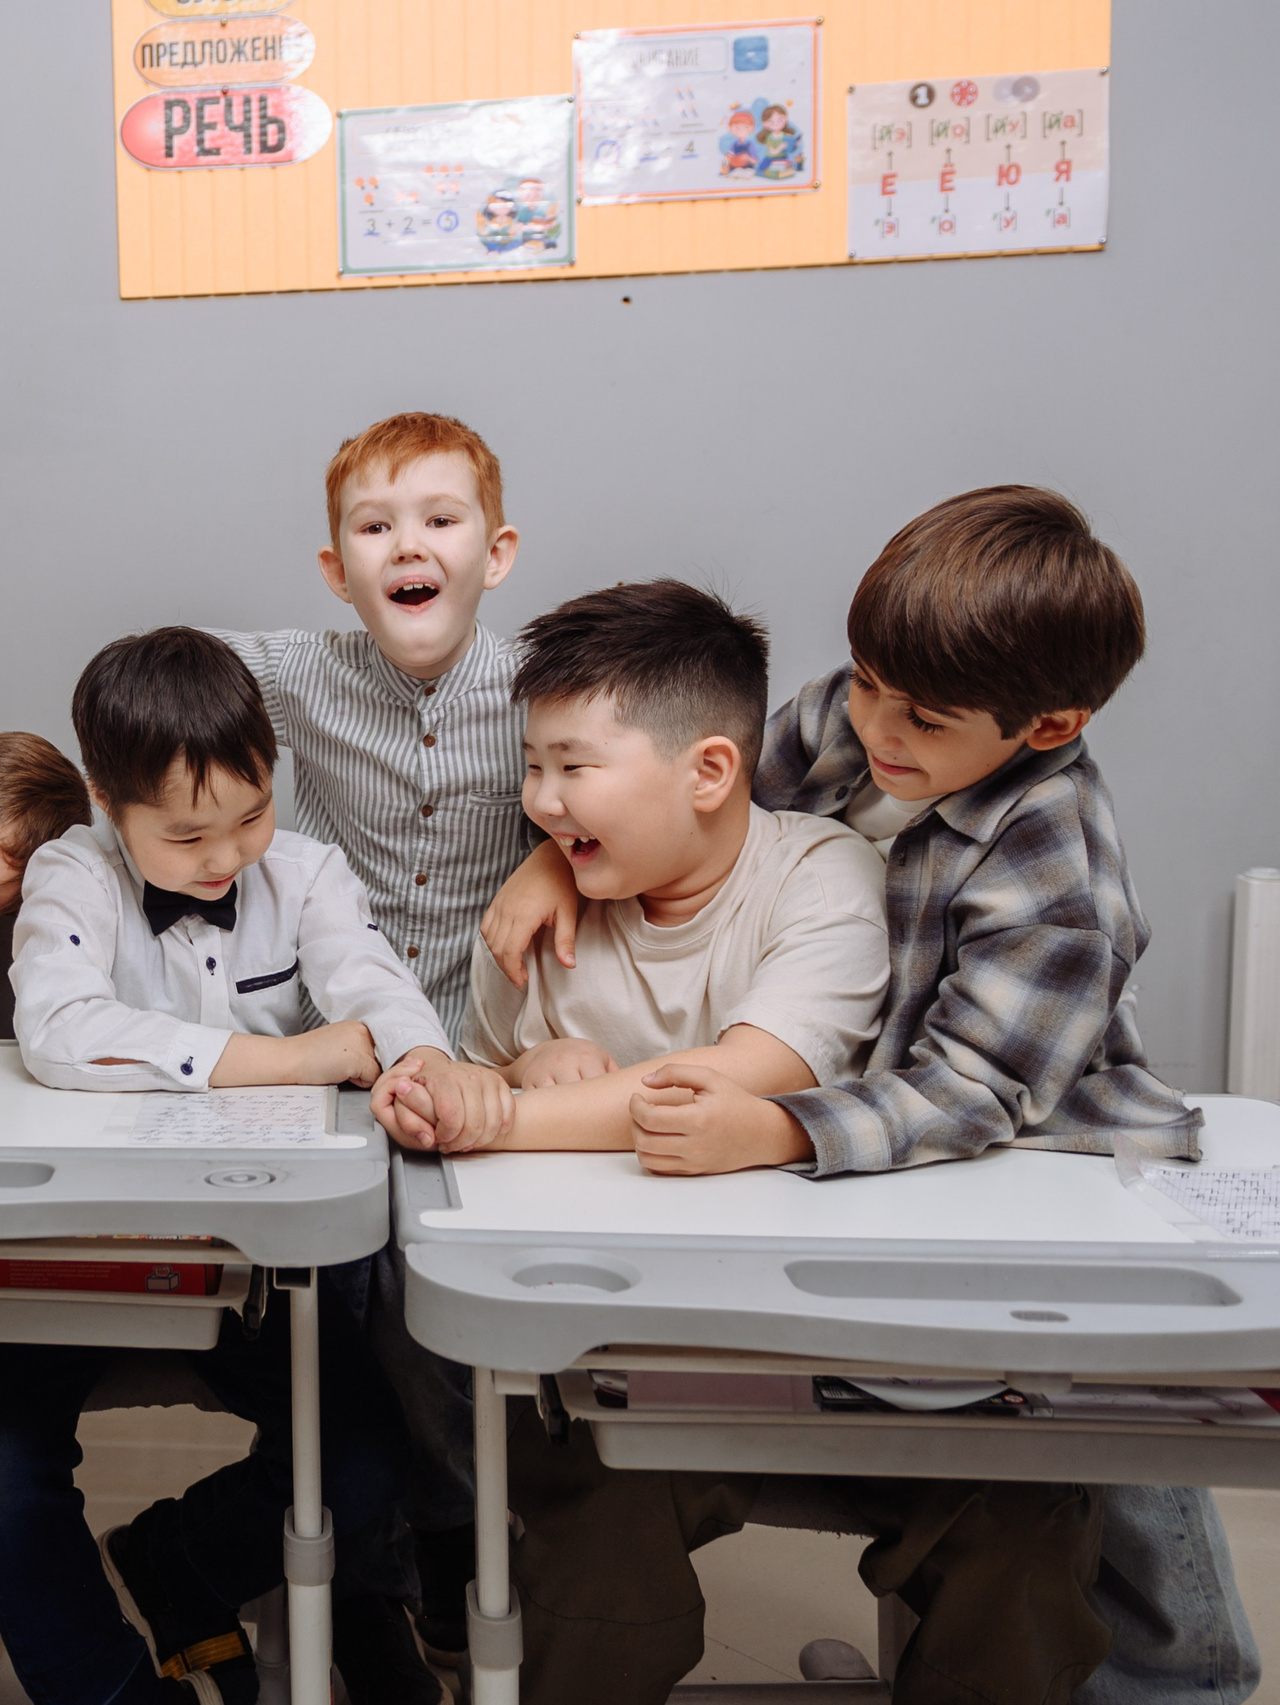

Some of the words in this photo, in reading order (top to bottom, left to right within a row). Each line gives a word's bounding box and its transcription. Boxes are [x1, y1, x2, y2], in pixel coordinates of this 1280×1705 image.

[163, 94, 287, 158] РЕЧЬ
[881, 172, 898, 196] Е
[939, 162, 956, 193] Ё
[997, 161, 1021, 187] Ю
[1054, 159, 1072, 183] Я
[367, 218, 376, 233] 3
[403, 216, 414, 231] 2
